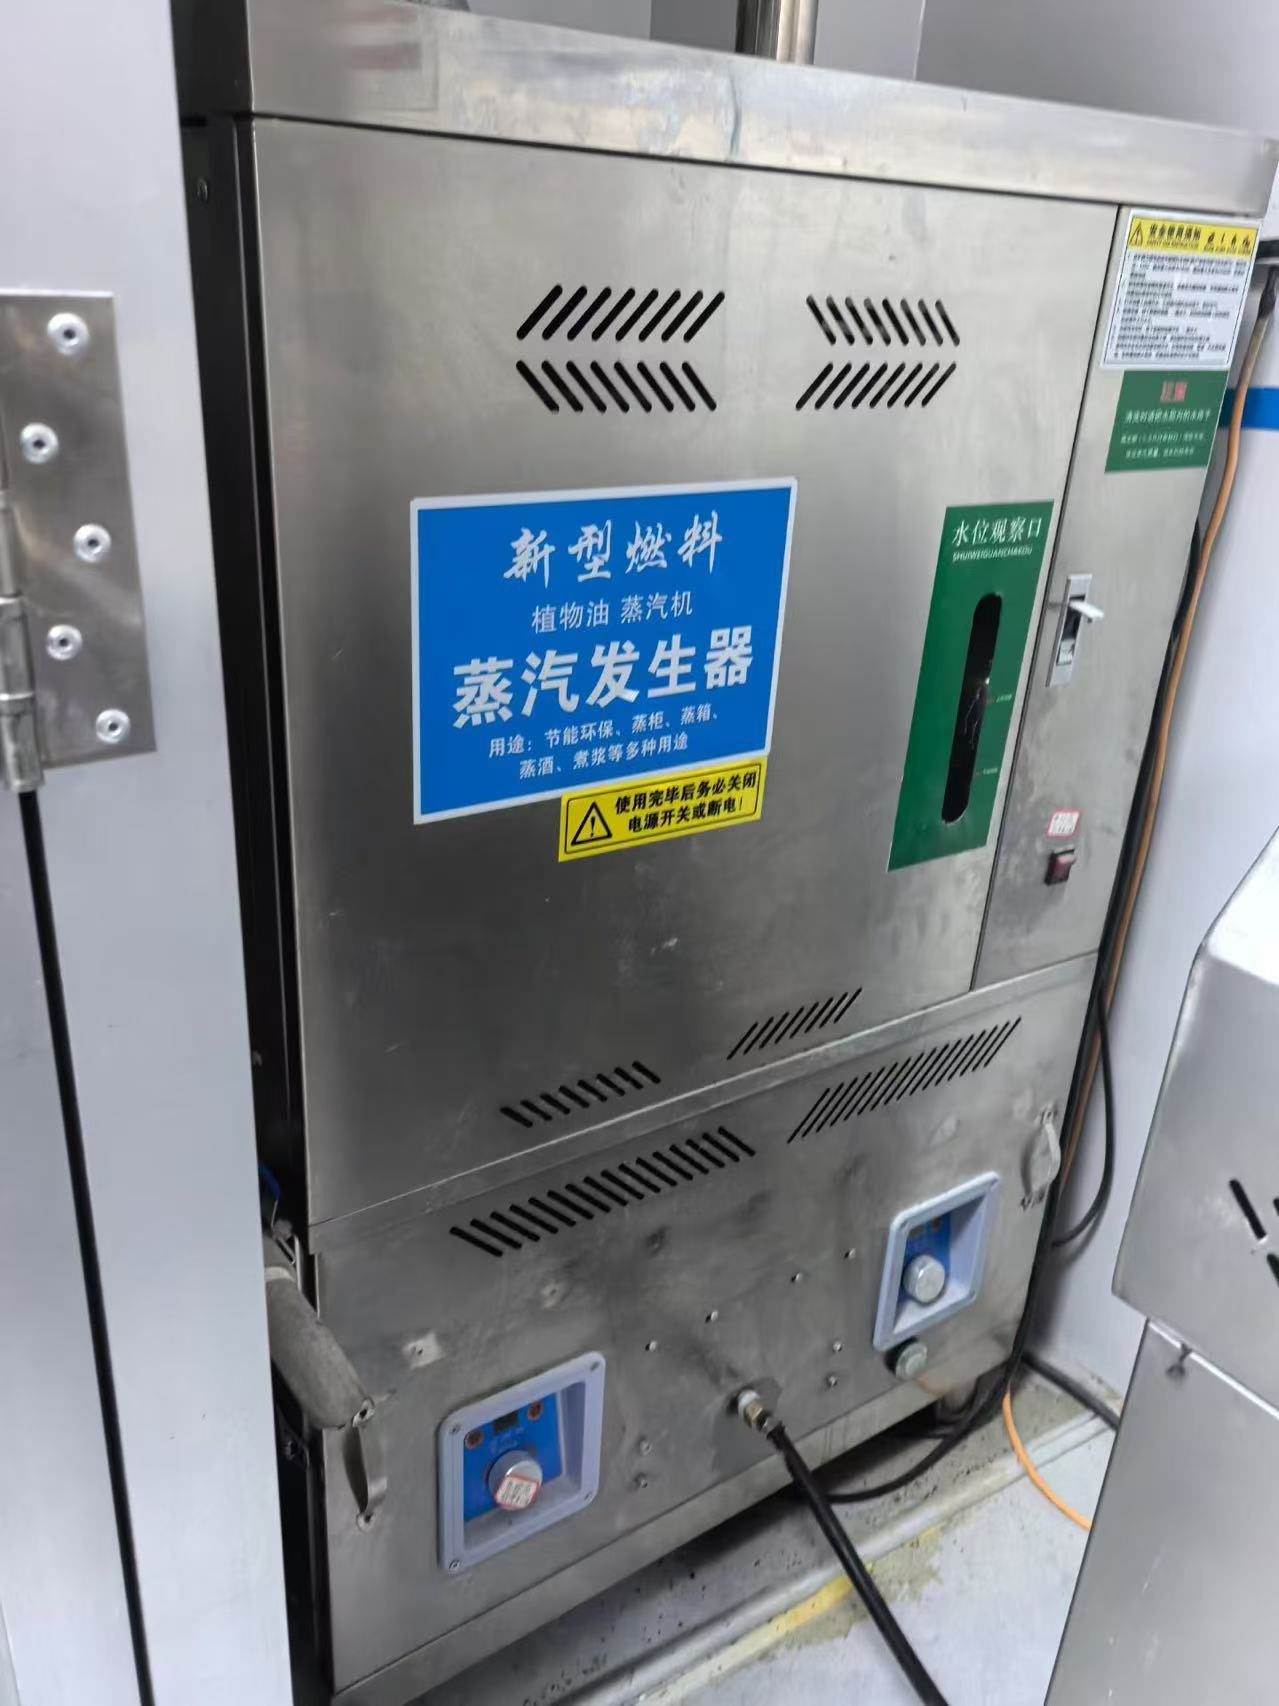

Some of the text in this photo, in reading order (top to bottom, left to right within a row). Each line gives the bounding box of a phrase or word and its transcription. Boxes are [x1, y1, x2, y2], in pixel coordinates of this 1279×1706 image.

[503, 509, 722, 589] 新型燃料
[531, 589, 693, 634] 植物油 蒸汽机
[452, 624, 753, 729] 蒸汽发生器
[519, 733, 688, 779] 蒸酒、煮浆等多种用途
[614, 770, 757, 815] 使用完毕后务必关闭
